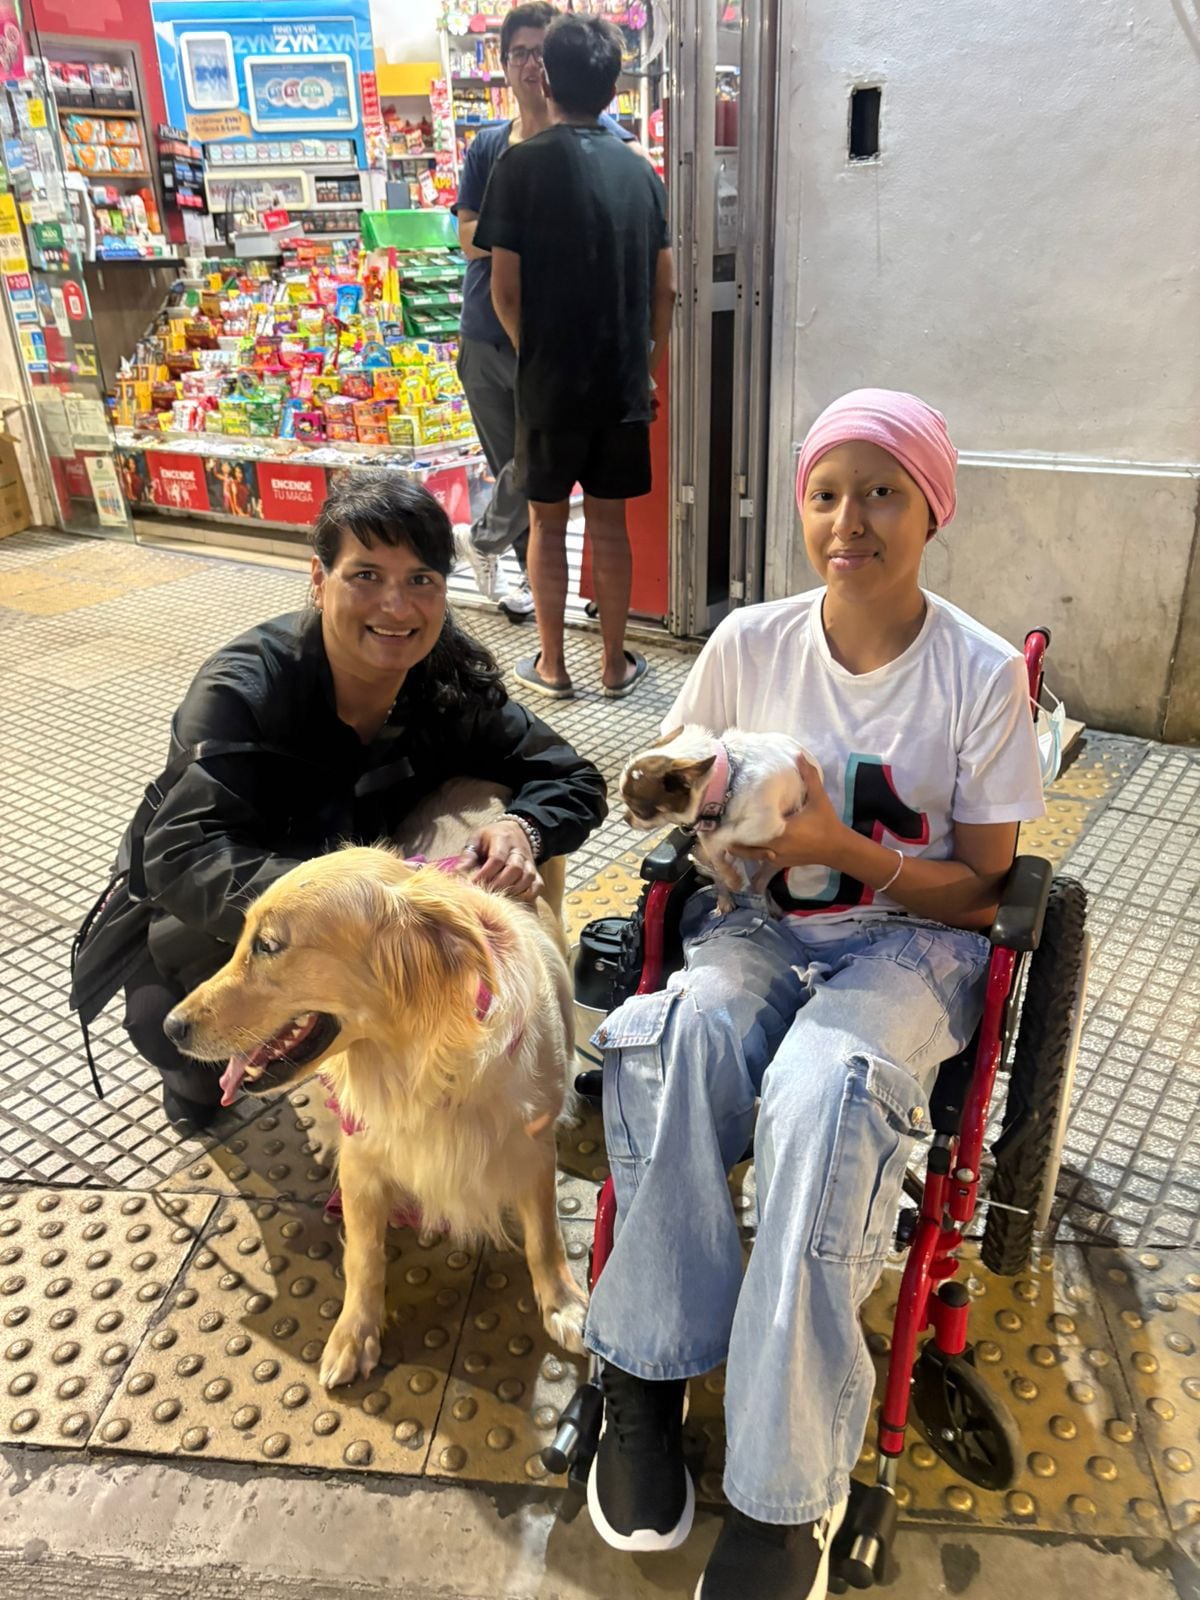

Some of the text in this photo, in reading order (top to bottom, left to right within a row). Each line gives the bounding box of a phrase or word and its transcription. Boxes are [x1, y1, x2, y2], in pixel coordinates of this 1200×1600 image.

[273, 24, 316, 34] FIND YOUR
[275, 34, 318, 53] ZYN
[160, 467, 195, 480] ENCENDÉ
[271, 478, 312, 492] ENCENDÉ
[274, 490, 313, 502] TU MAGIA
